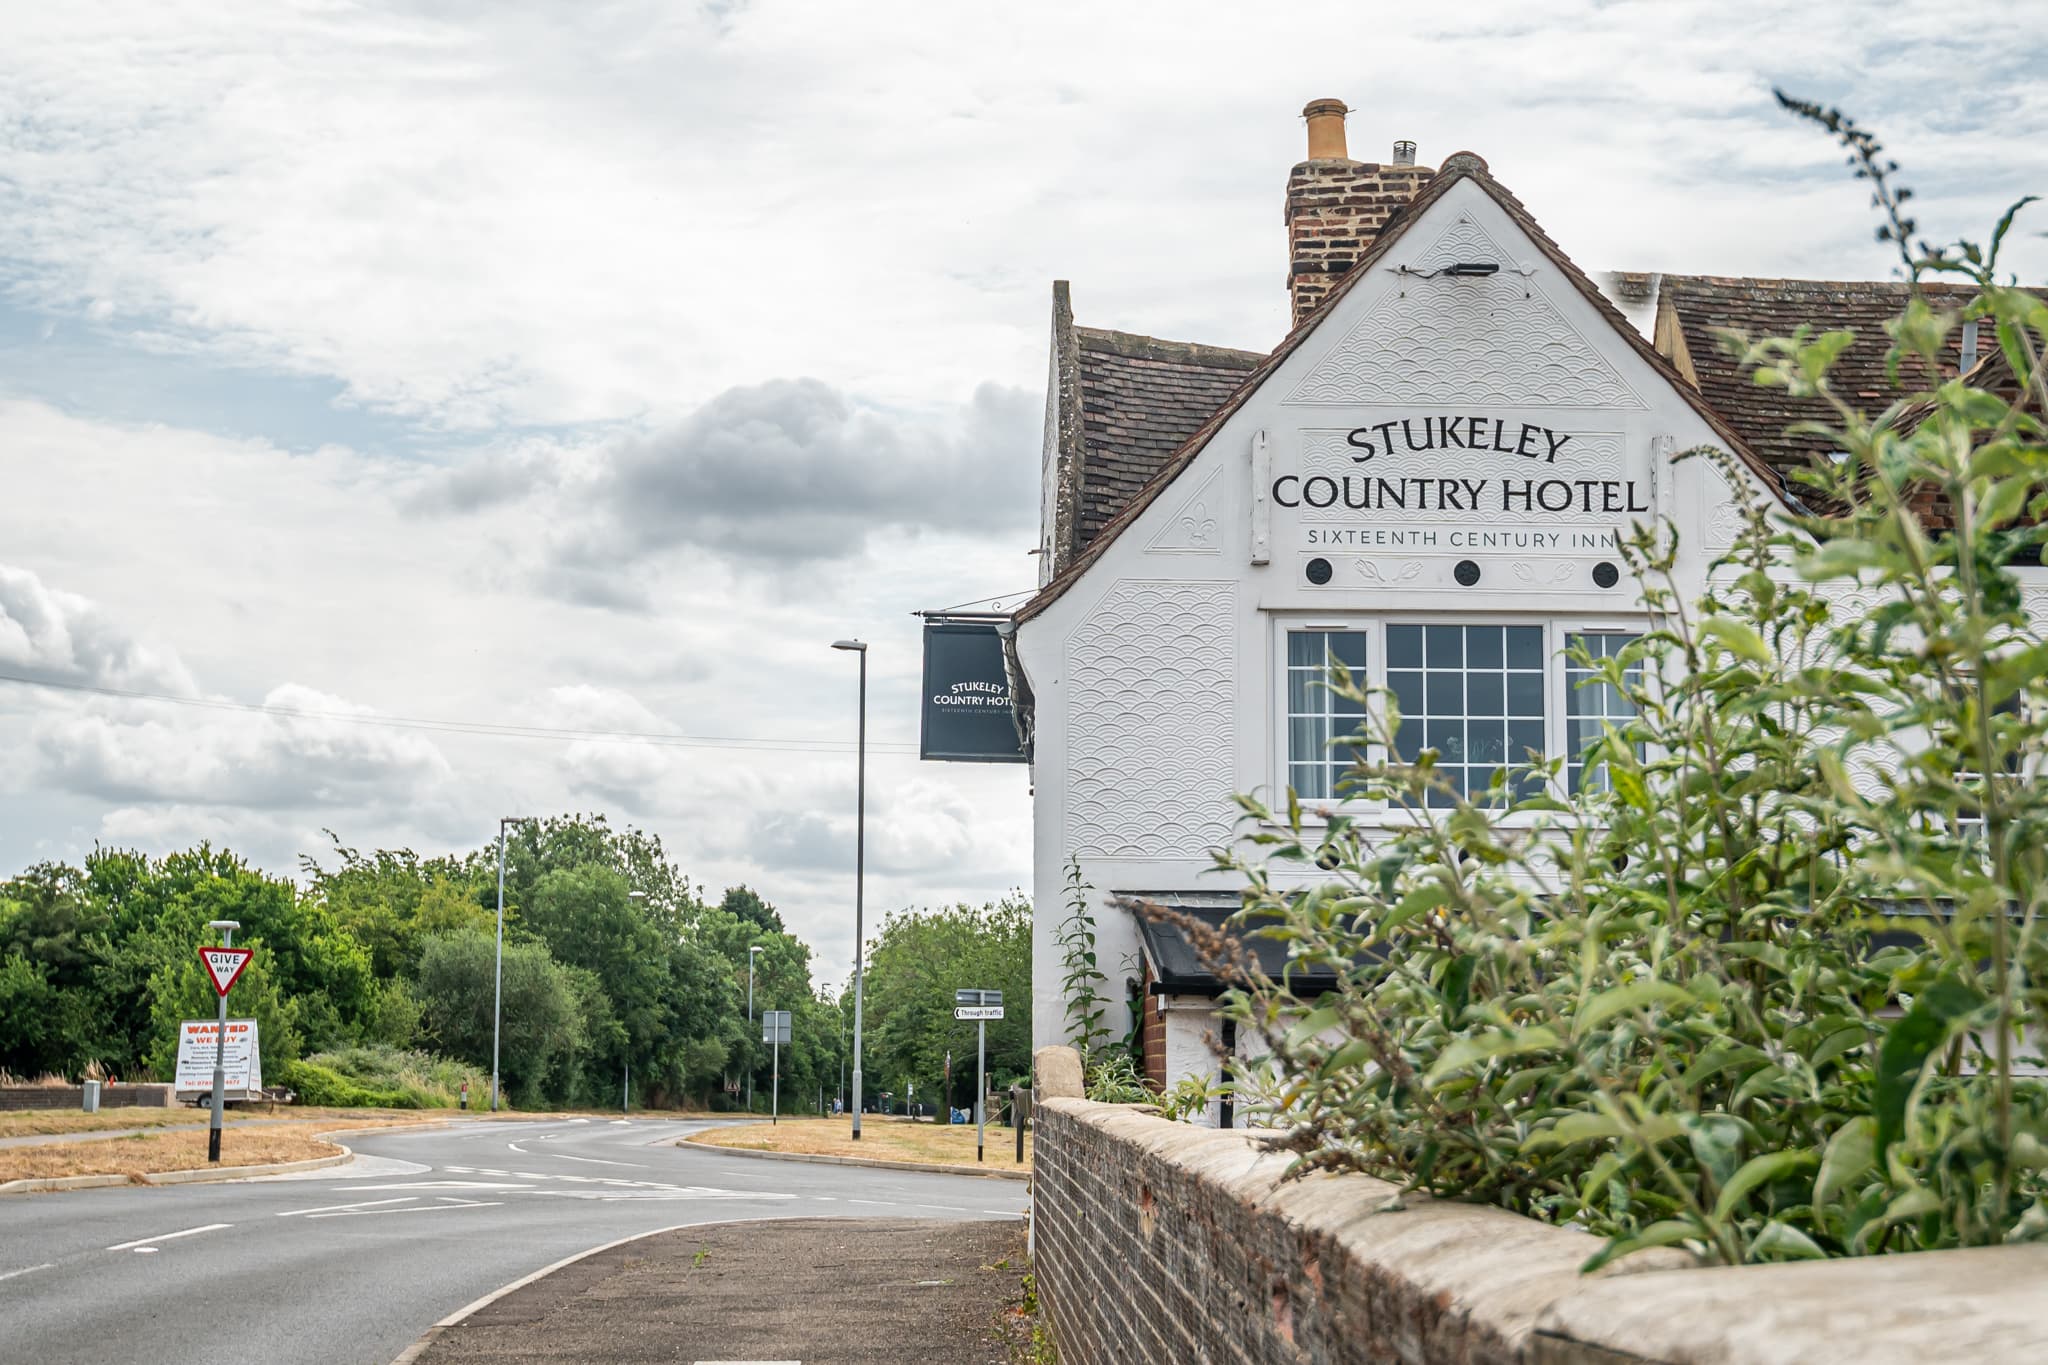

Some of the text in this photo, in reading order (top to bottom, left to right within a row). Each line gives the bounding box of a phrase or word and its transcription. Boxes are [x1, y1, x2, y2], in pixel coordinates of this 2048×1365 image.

[1347, 416, 1572, 464] STUKELEY
[1272, 475, 1649, 512] COUNTRY HOTEL
[1308, 529, 1614, 548] SIXTEENTH CENTURY INN
[951, 681, 1004, 694] STUKELEY
[933, 695, 1013, 706] COUNTRY HOT
[210, 953, 240, 964] GIVE
[961, 1009, 984, 1017] Through
[196, 1036, 212, 1044] WE
